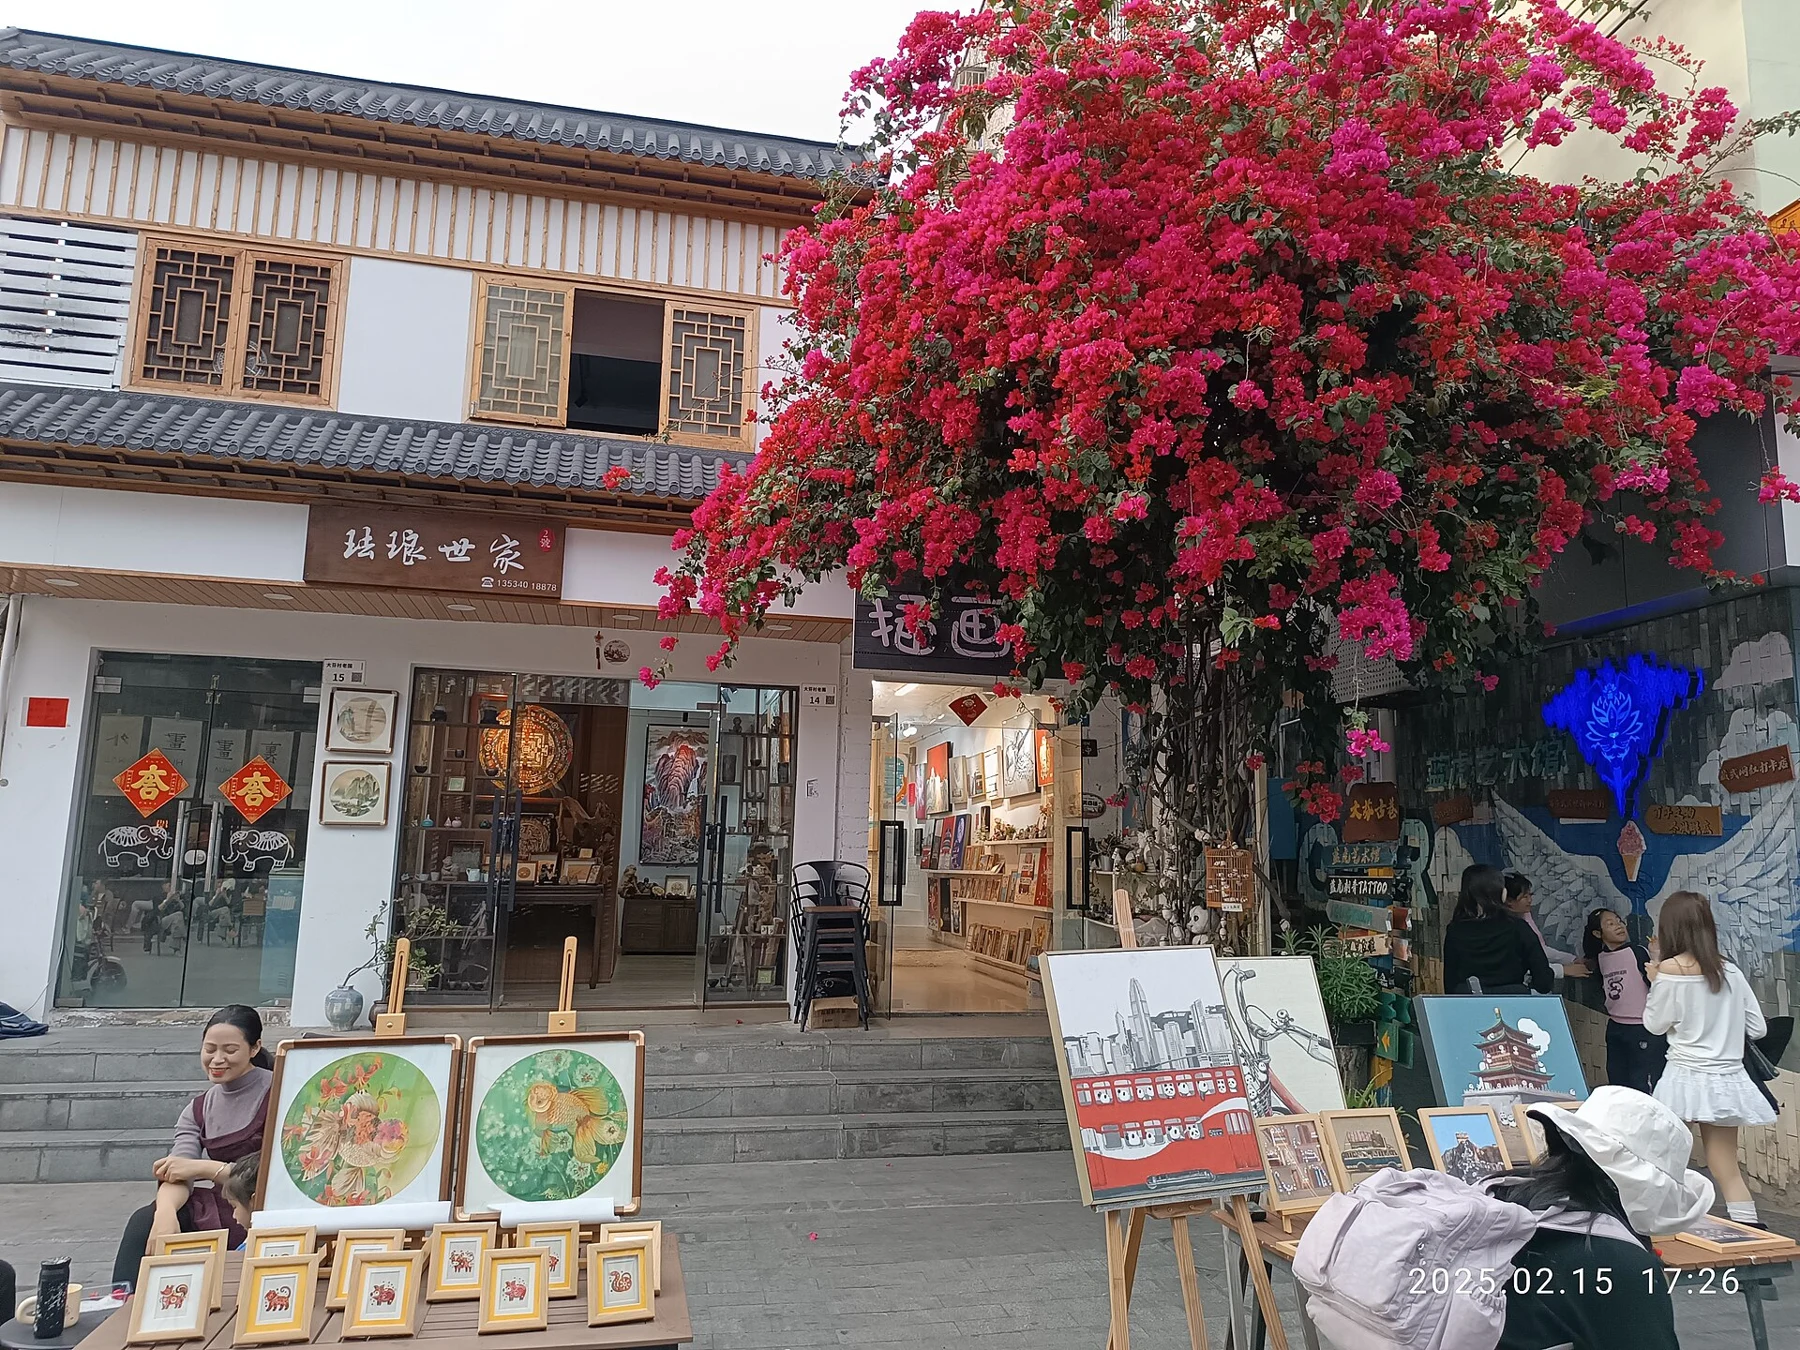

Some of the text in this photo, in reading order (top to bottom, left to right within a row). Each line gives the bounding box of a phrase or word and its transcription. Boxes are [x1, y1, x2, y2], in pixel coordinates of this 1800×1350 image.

[343, 526, 525, 574] 珐琅世家
[497, 579, 557, 592] 135340 18878
[333, 673, 345, 682] 15
[809, 696, 820, 704] 14
